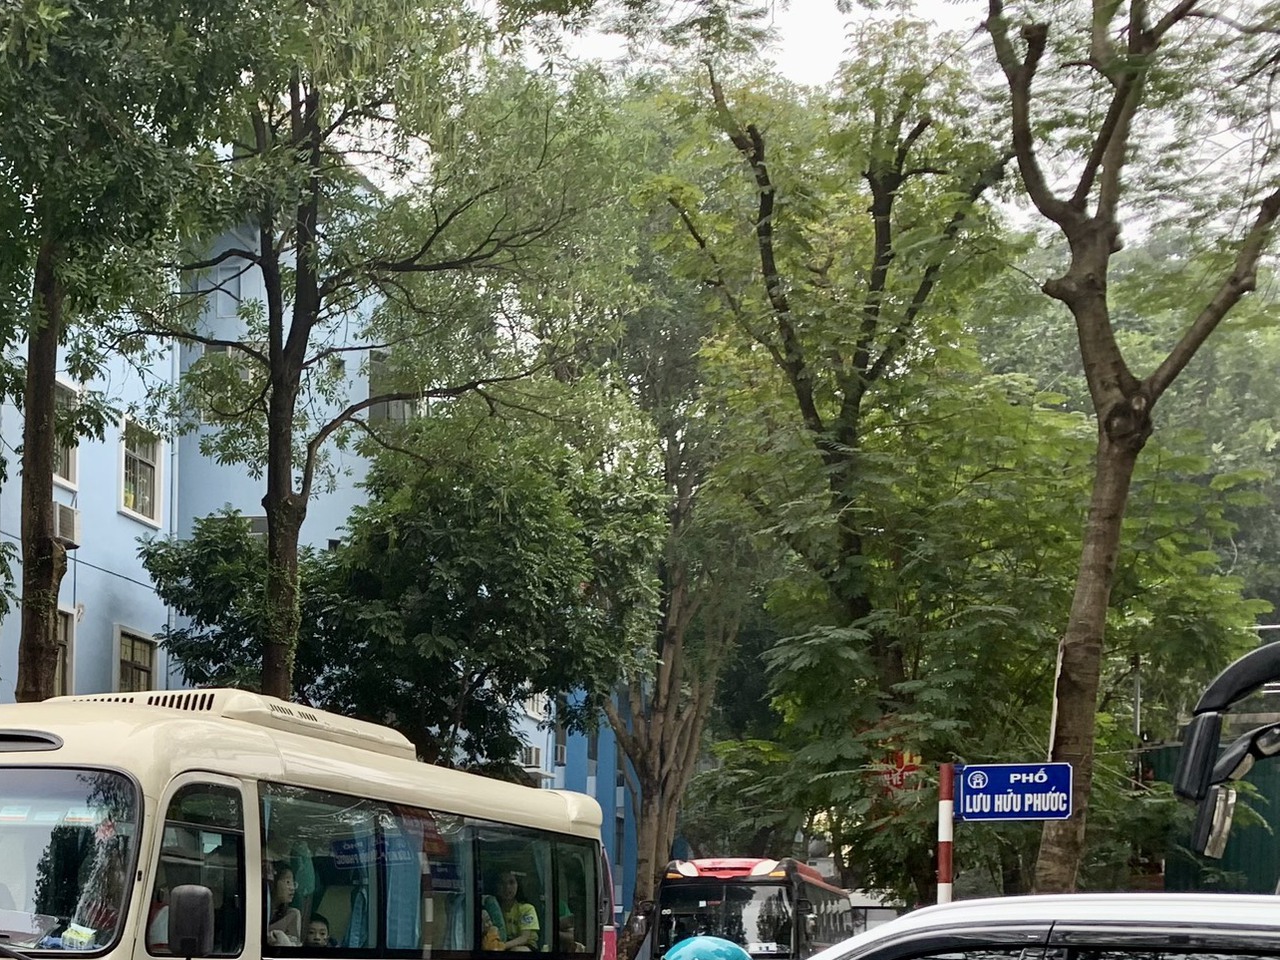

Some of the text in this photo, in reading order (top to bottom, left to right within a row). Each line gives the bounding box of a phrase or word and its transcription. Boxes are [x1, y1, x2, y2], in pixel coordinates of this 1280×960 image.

[1009, 767, 1048, 784] PHỐ
[965, 785, 1067, 813] LƯU HỮU PHƯỚC
